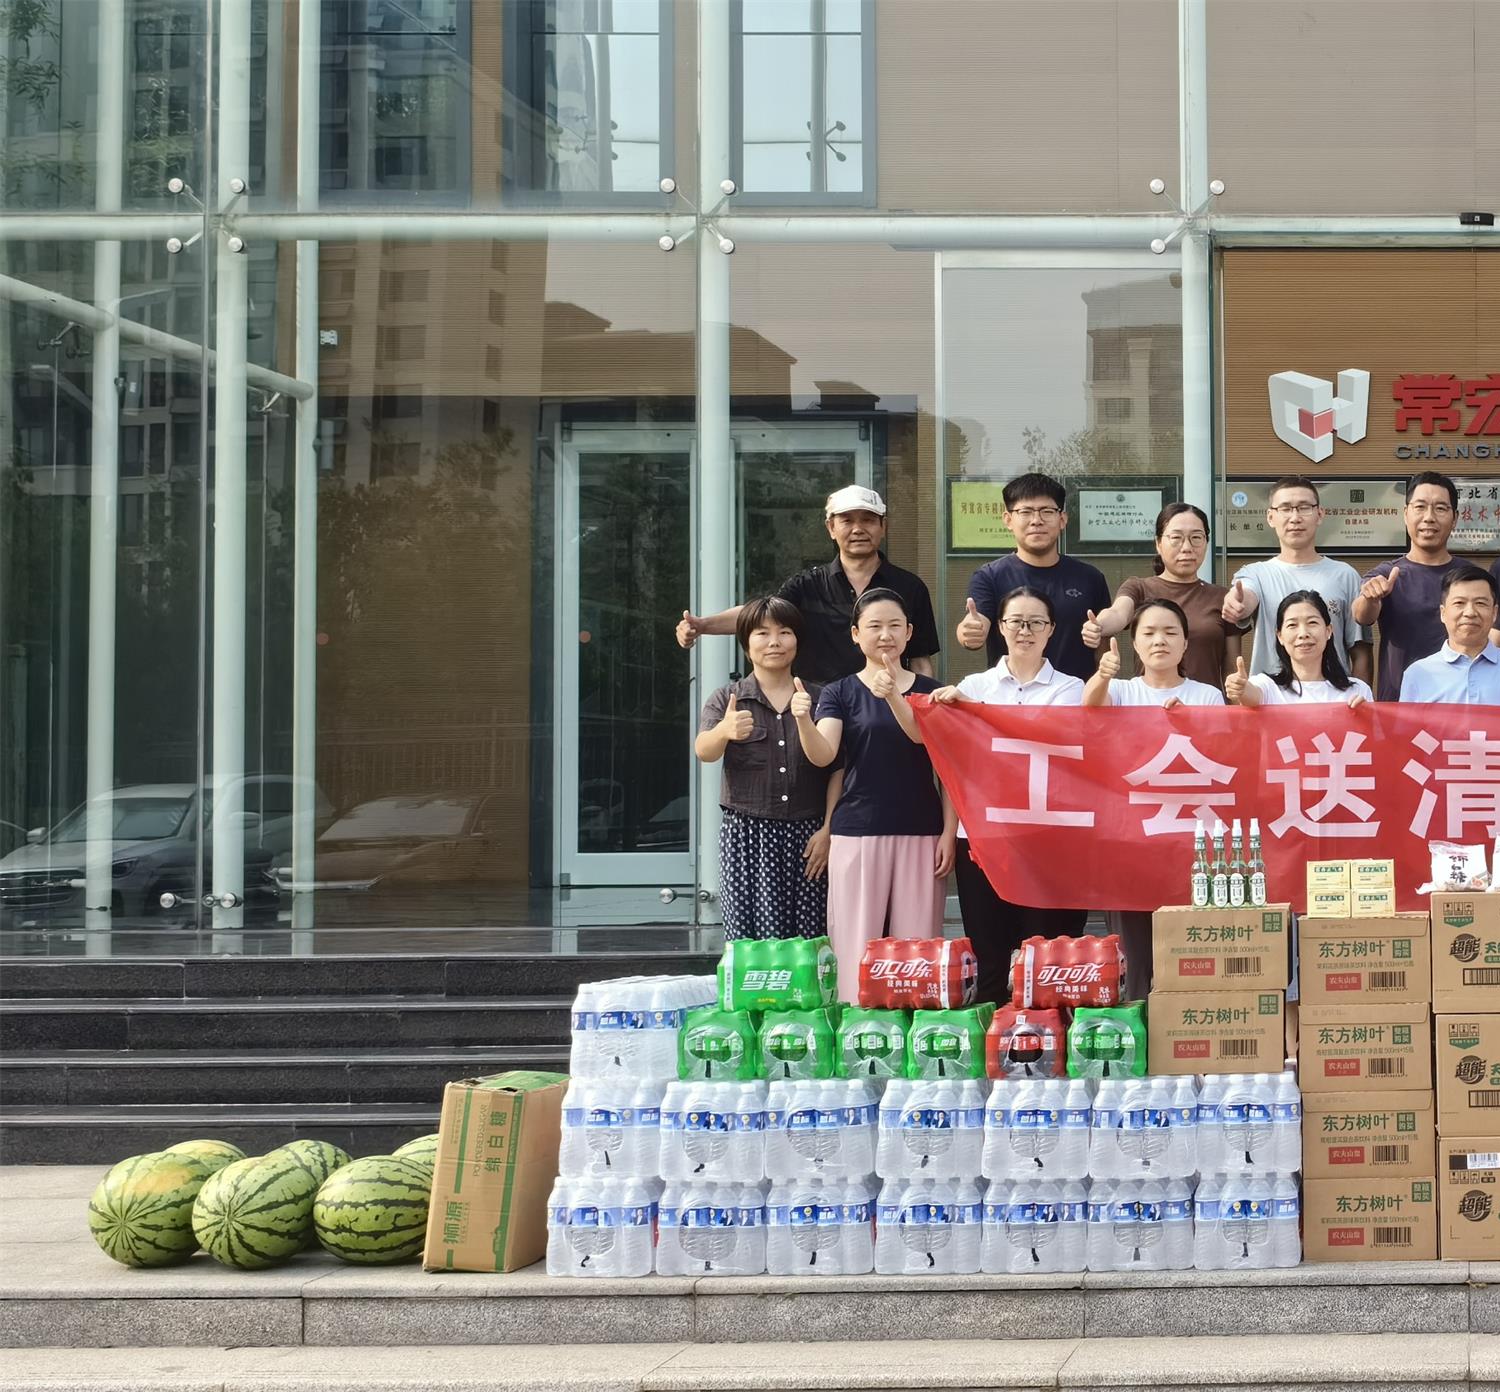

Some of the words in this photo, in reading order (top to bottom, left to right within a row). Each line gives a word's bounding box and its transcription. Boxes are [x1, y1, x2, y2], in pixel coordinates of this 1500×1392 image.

[1186, 925, 1254, 942] 东方树叶
[1318, 940, 1386, 958] 东方树叶
[1449, 937, 1481, 956] 超能
[870, 957, 936, 980] 可口可乐
[1038, 962, 1105, 986] 可口可乐
[740, 970, 792, 991] 雪碧
[887, 980, 918, 988] 经典美味
[1055, 985, 1088, 993] 经典美味
[1182, 1007, 1250, 1025] 东方树叶
[1318, 1026, 1385, 1044] 东方树叶
[1454, 1059, 1487, 1078] 超能
[478, 1104, 488, 1131] SUGAR
[1322, 1113, 1390, 1132] 东方树叶
[484, 1111, 507, 1173] 绵白糖
[1336, 1194, 1404, 1212] 东方树叶
[1458, 1194, 1493, 1215] 超能
[443, 1200, 464, 1244] 狮源
